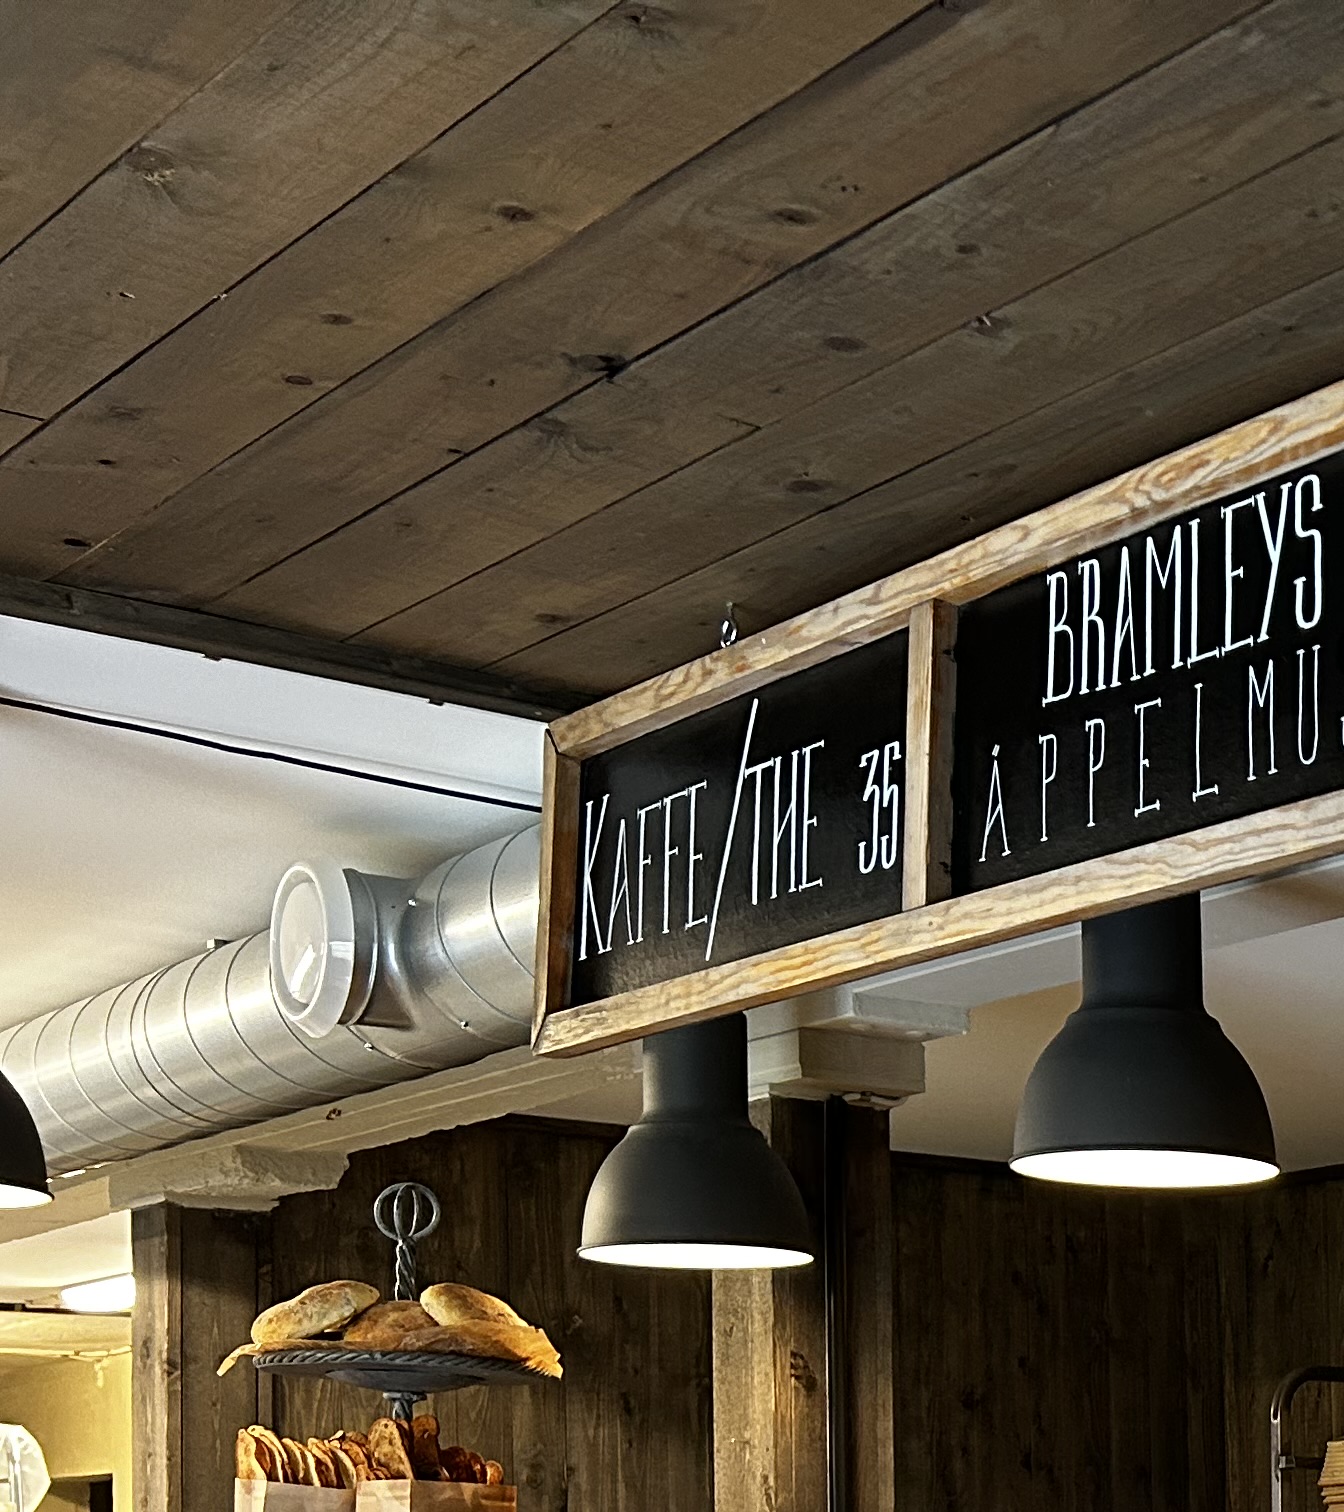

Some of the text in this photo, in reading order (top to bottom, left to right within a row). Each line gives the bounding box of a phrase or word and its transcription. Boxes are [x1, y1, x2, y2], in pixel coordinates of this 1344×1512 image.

[1042, 474, 1323, 707] BRAMLEYS
[578, 698, 902, 962] KAFFE/THE 35
